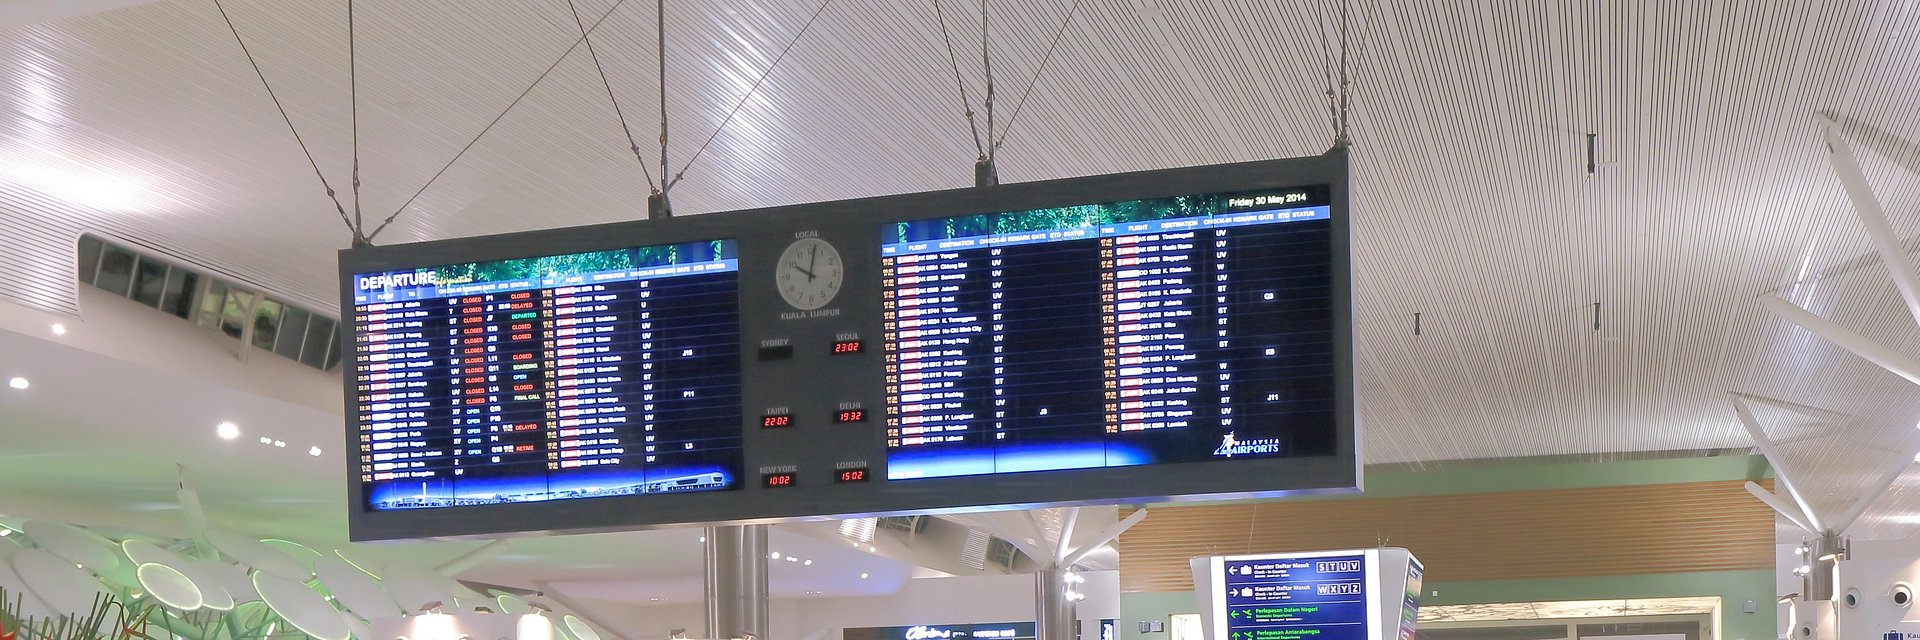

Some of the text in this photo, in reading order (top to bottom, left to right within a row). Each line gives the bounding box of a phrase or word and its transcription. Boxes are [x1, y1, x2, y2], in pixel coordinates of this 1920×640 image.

[1229, 193, 1306, 207] Friday 30 May 2014
[795, 230, 819, 238] LOCAL
[360, 271, 435, 289] DEPARTURE
[781, 309, 840, 319] KUALA LUMPUR
[761, 339, 788, 347] SYDNEY
[840, 402, 860, 410] DELHI
[766, 407, 788, 415] TAIPEI
[1231, 444, 1278, 454] AIRPORTS
[836, 461, 867, 469] LONDON
[760, 465, 797, 474] NEW YORK
[1340, 562, 1346, 570] U
[1351, 562, 1357, 570] V
